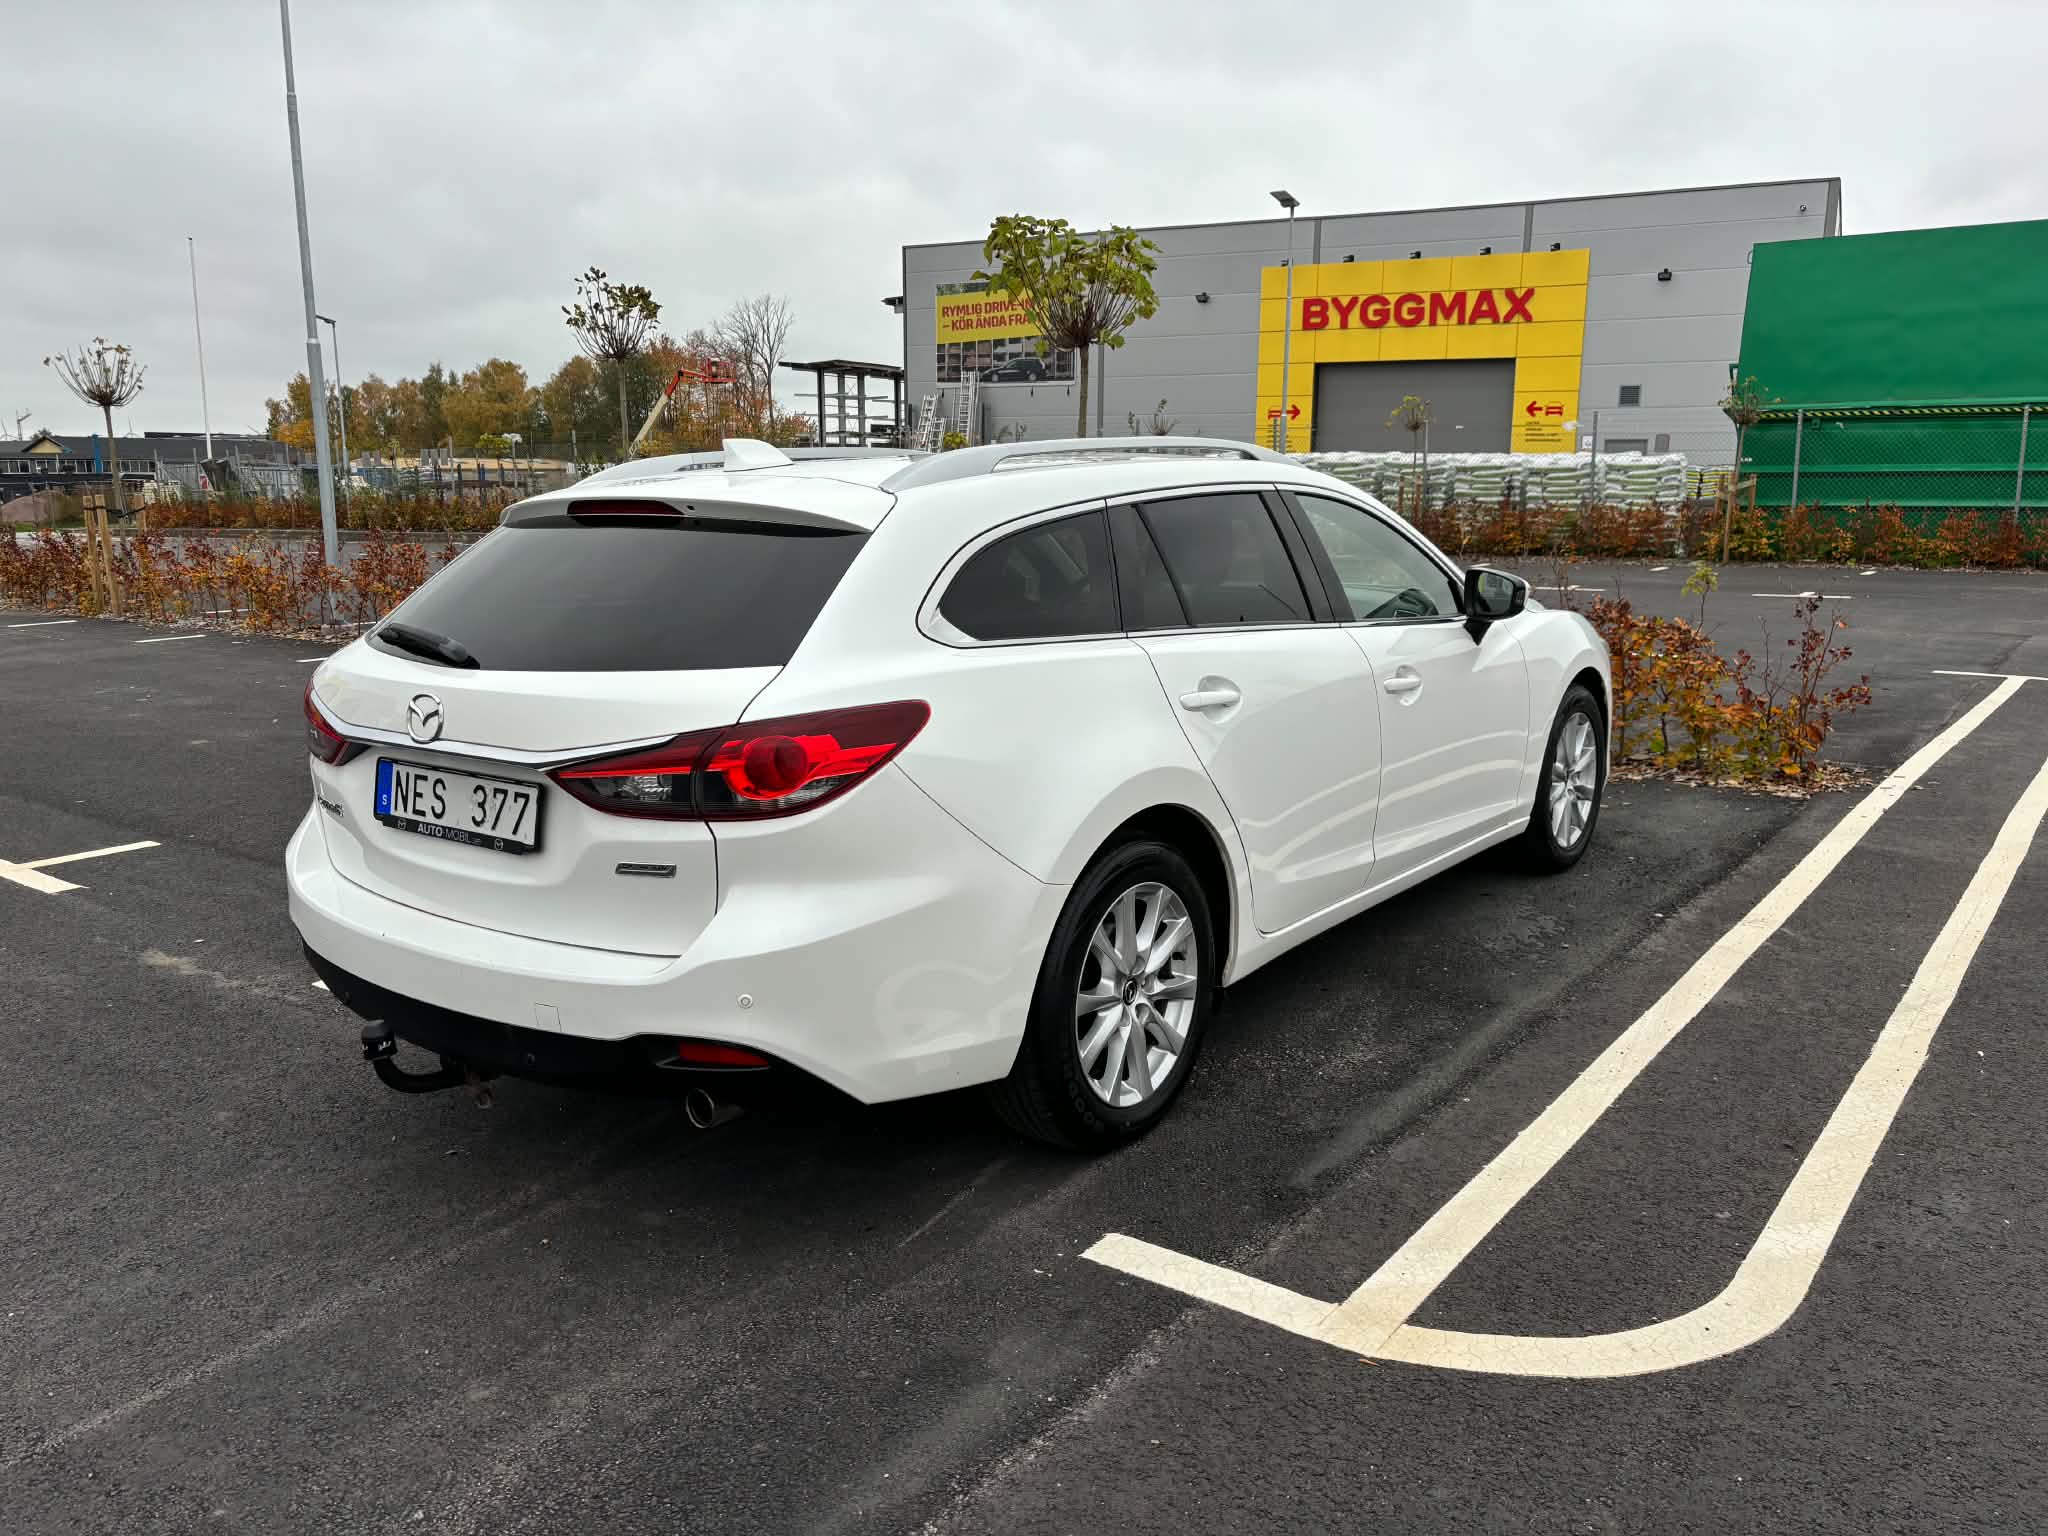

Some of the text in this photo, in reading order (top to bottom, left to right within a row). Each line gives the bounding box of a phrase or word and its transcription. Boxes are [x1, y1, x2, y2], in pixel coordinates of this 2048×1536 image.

[942, 303, 983, 318] RYMLIG
[952, 316, 974, 332] KÖR
[976, 312, 1007, 329] ÄNDA
[1302, 288, 1535, 331] BYGGMAX
[382, 794, 388, 805] S
[394, 770, 447, 820] NES
[471, 784, 530, 836] 377
